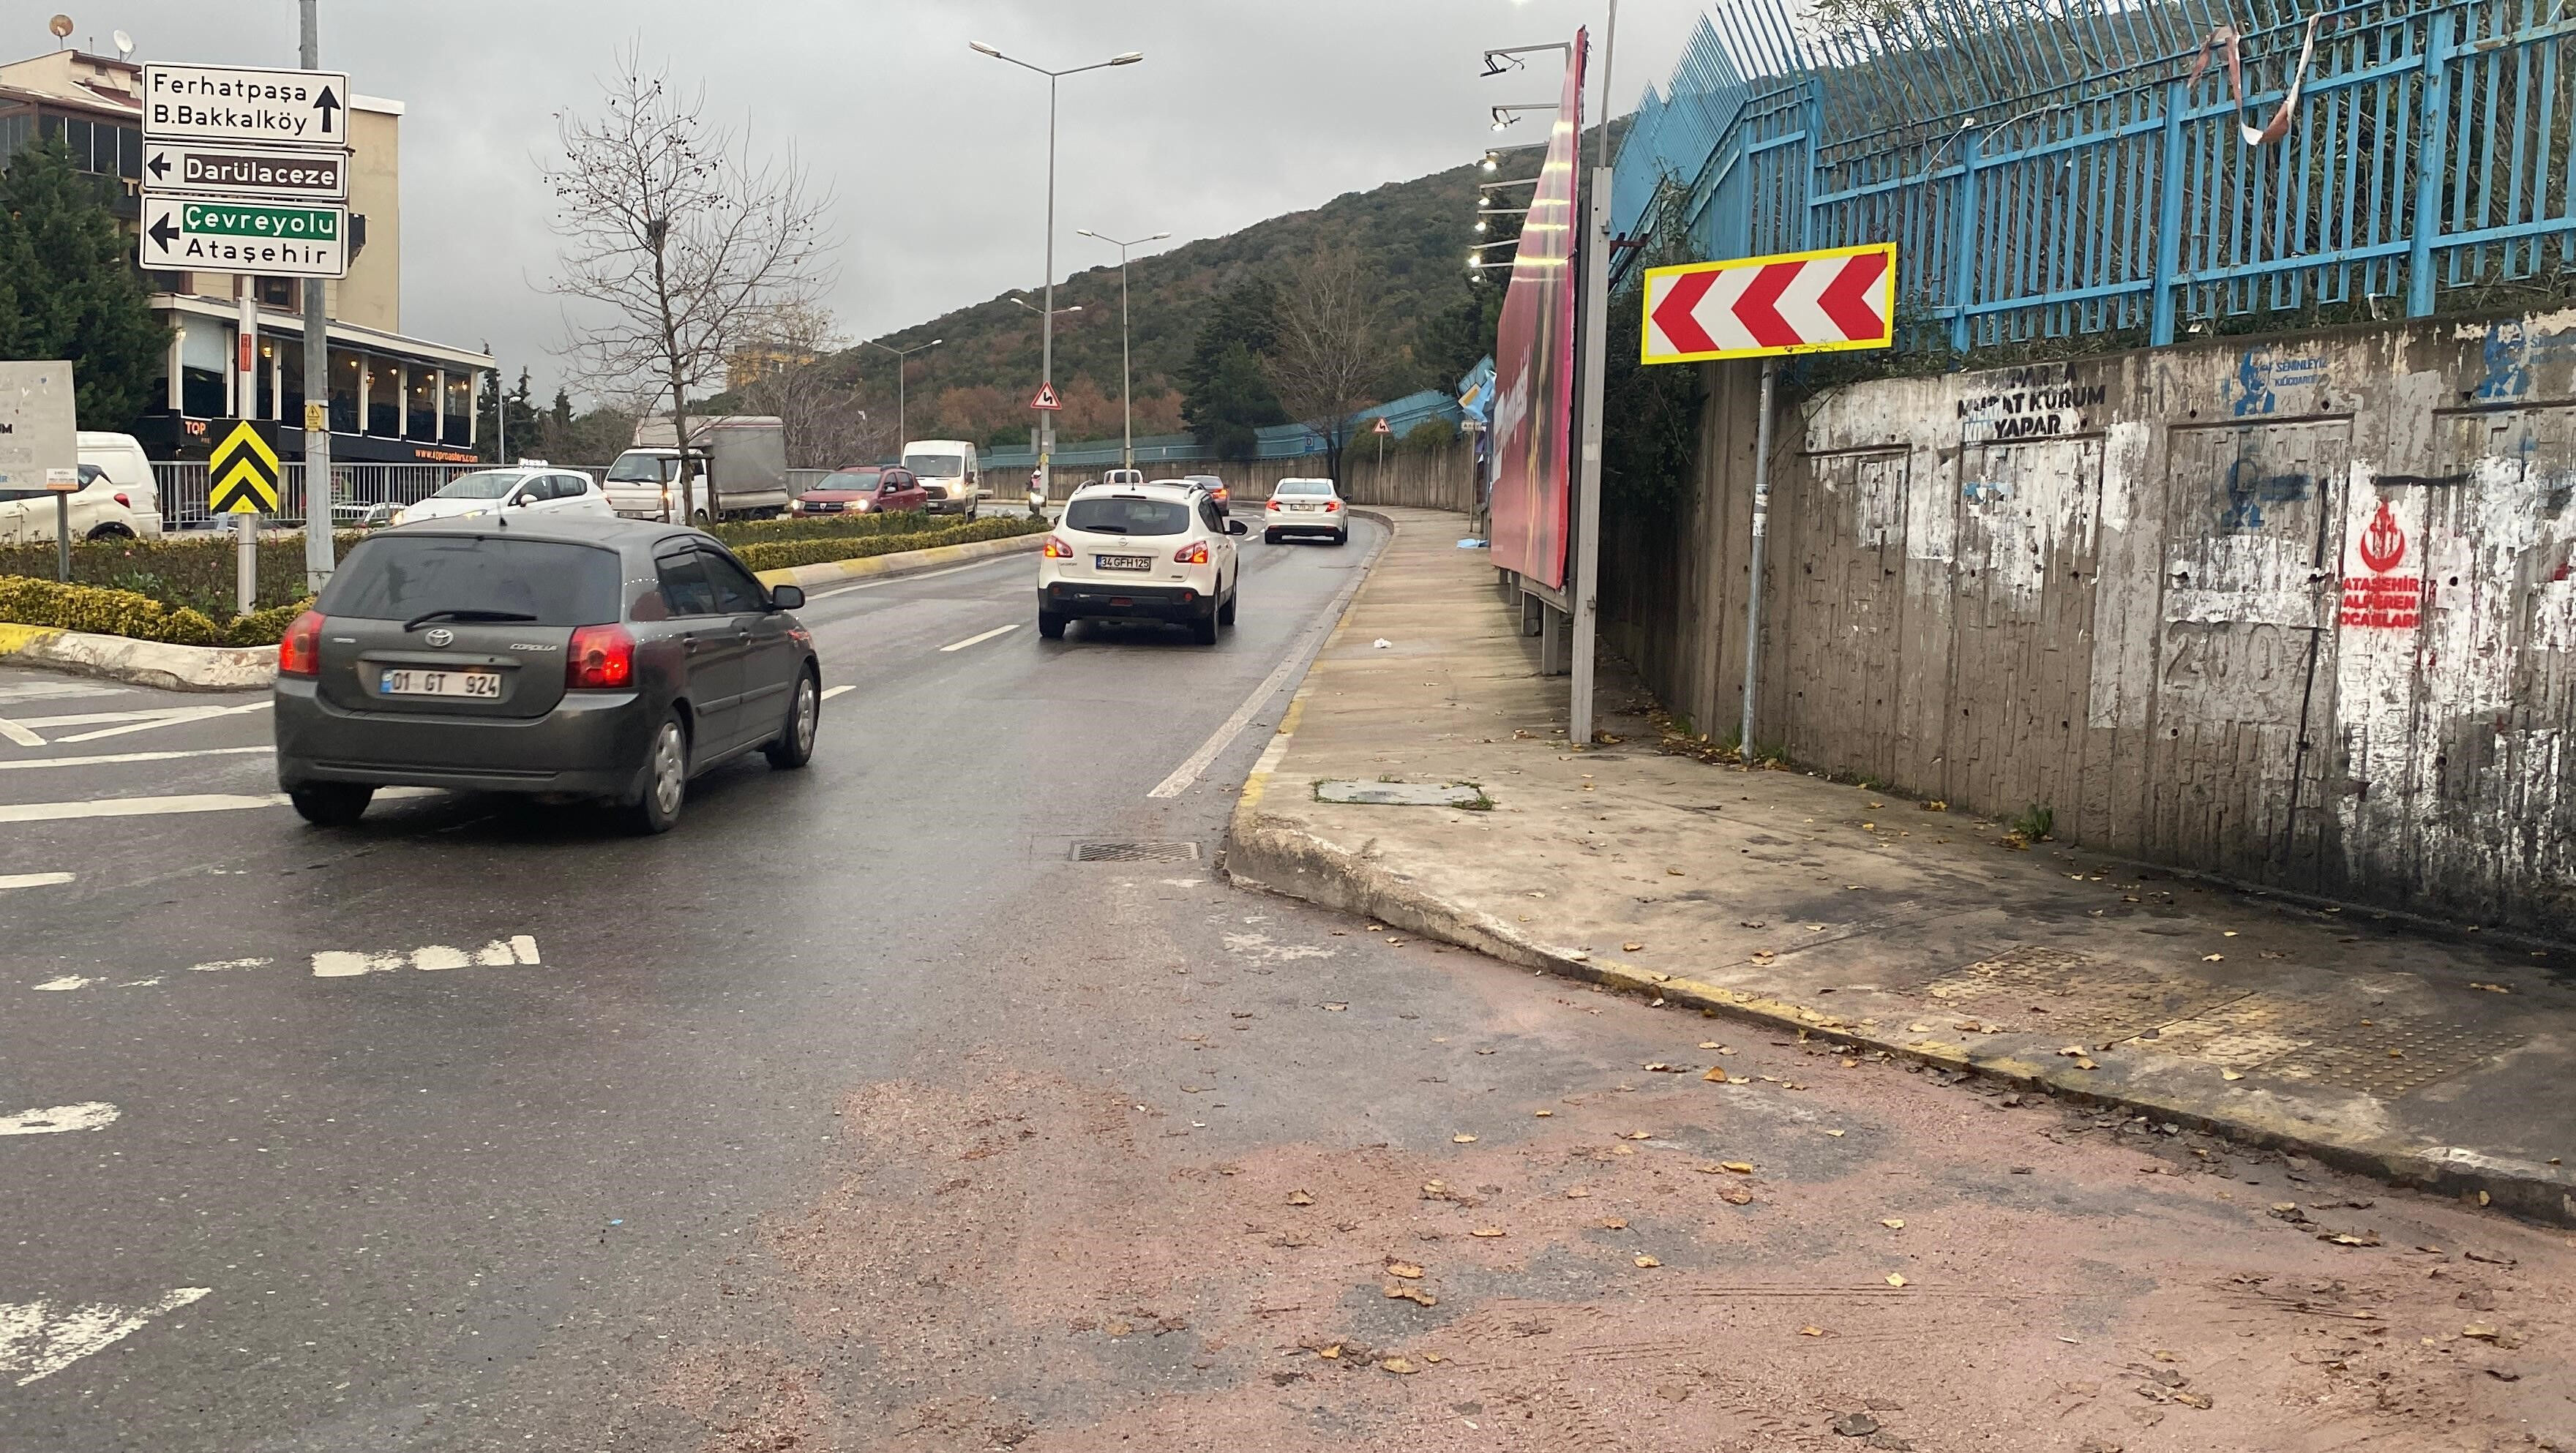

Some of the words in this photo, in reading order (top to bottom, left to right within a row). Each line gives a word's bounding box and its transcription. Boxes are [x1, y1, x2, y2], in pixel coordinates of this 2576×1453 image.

[154, 74, 307, 104] Ferhatpaşa
[154, 105, 307, 136] B.Bakkalköy
[185, 159, 336, 186] Darülaceze
[185, 206, 334, 237] Çevreyolu
[186, 238, 326, 263] Ataşehir
[2029, 385, 2106, 412] KURUM
[0, 423, 12, 435] M
[184, 421, 206, 435] TOP
[1994, 414, 2062, 439] YAPAR
[1101, 557, 1112, 566] 34
[1114, 558, 1134, 568] GFH
[1135, 558, 1149, 568] 125
[2342, 576, 2420, 593] ATAŞEHİR
[2343, 594, 2416, 609] ALPEREN
[509, 643, 557, 651] COROLLA
[393, 672, 410, 691] 01
[424, 674, 446, 692] GT
[465, 676, 496, 695] 924
